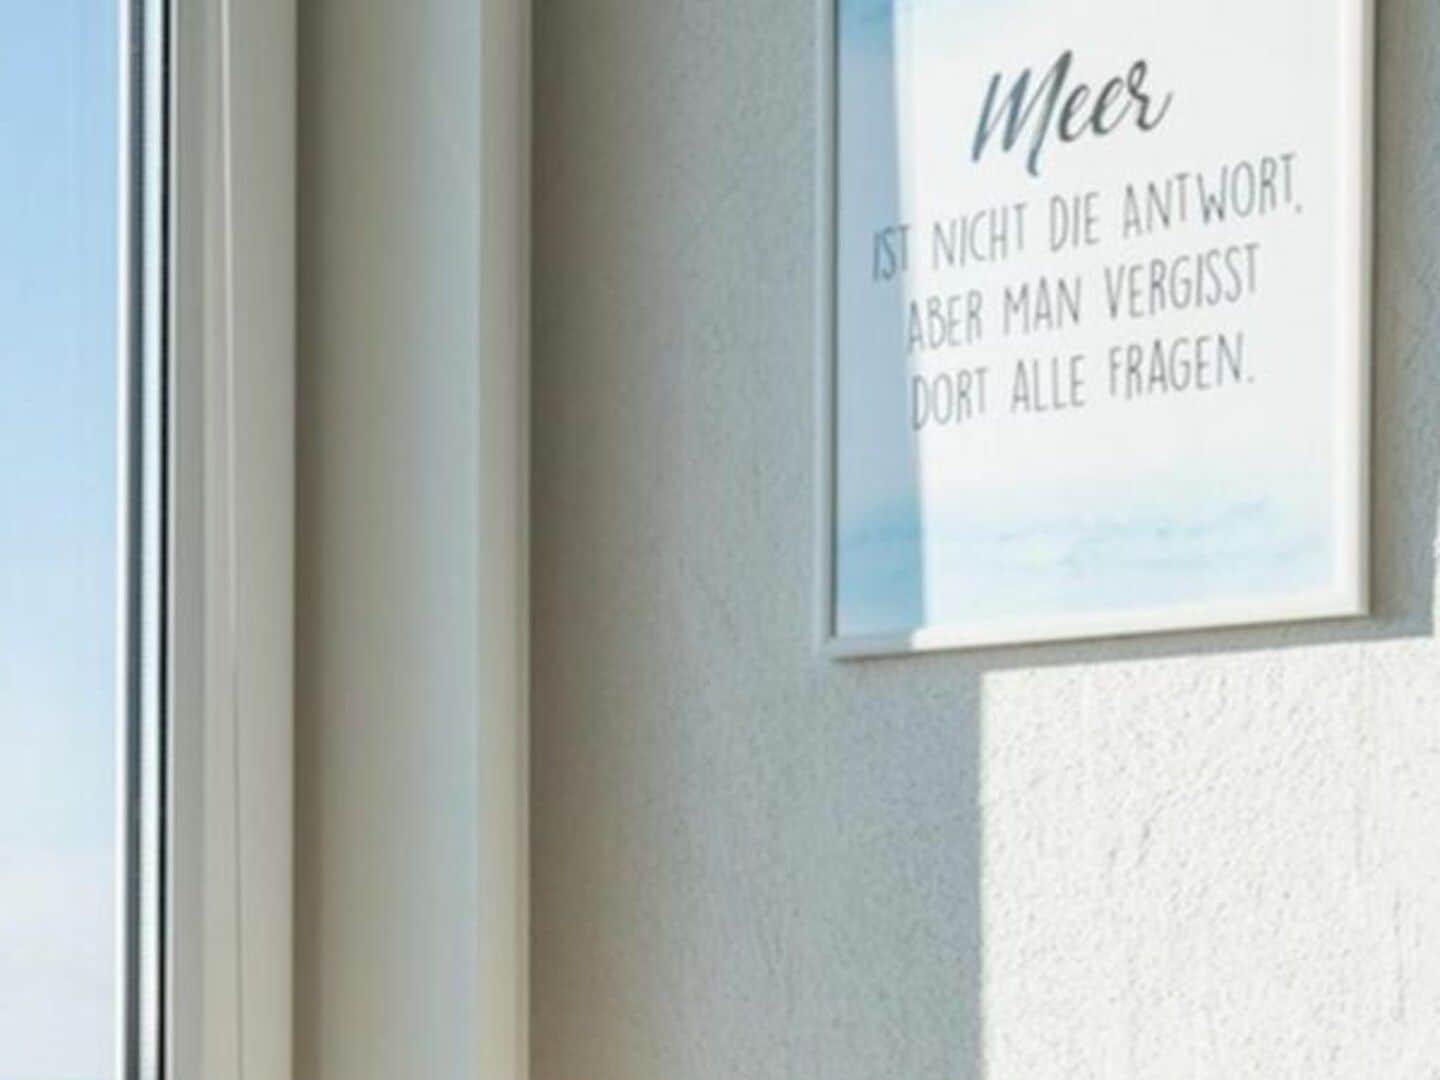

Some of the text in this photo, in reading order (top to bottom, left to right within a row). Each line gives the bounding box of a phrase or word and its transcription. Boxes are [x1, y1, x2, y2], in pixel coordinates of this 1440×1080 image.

[971, 49, 1173, 178] Meer
[872, 224, 910, 282] IST
[931, 202, 1028, 270] NICHT
[1049, 192, 1100, 252] DIE
[906, 243, 1260, 354] ABER MAN VERGISST
[912, 333, 1255, 430] DORT ALLE FRAGEN.
